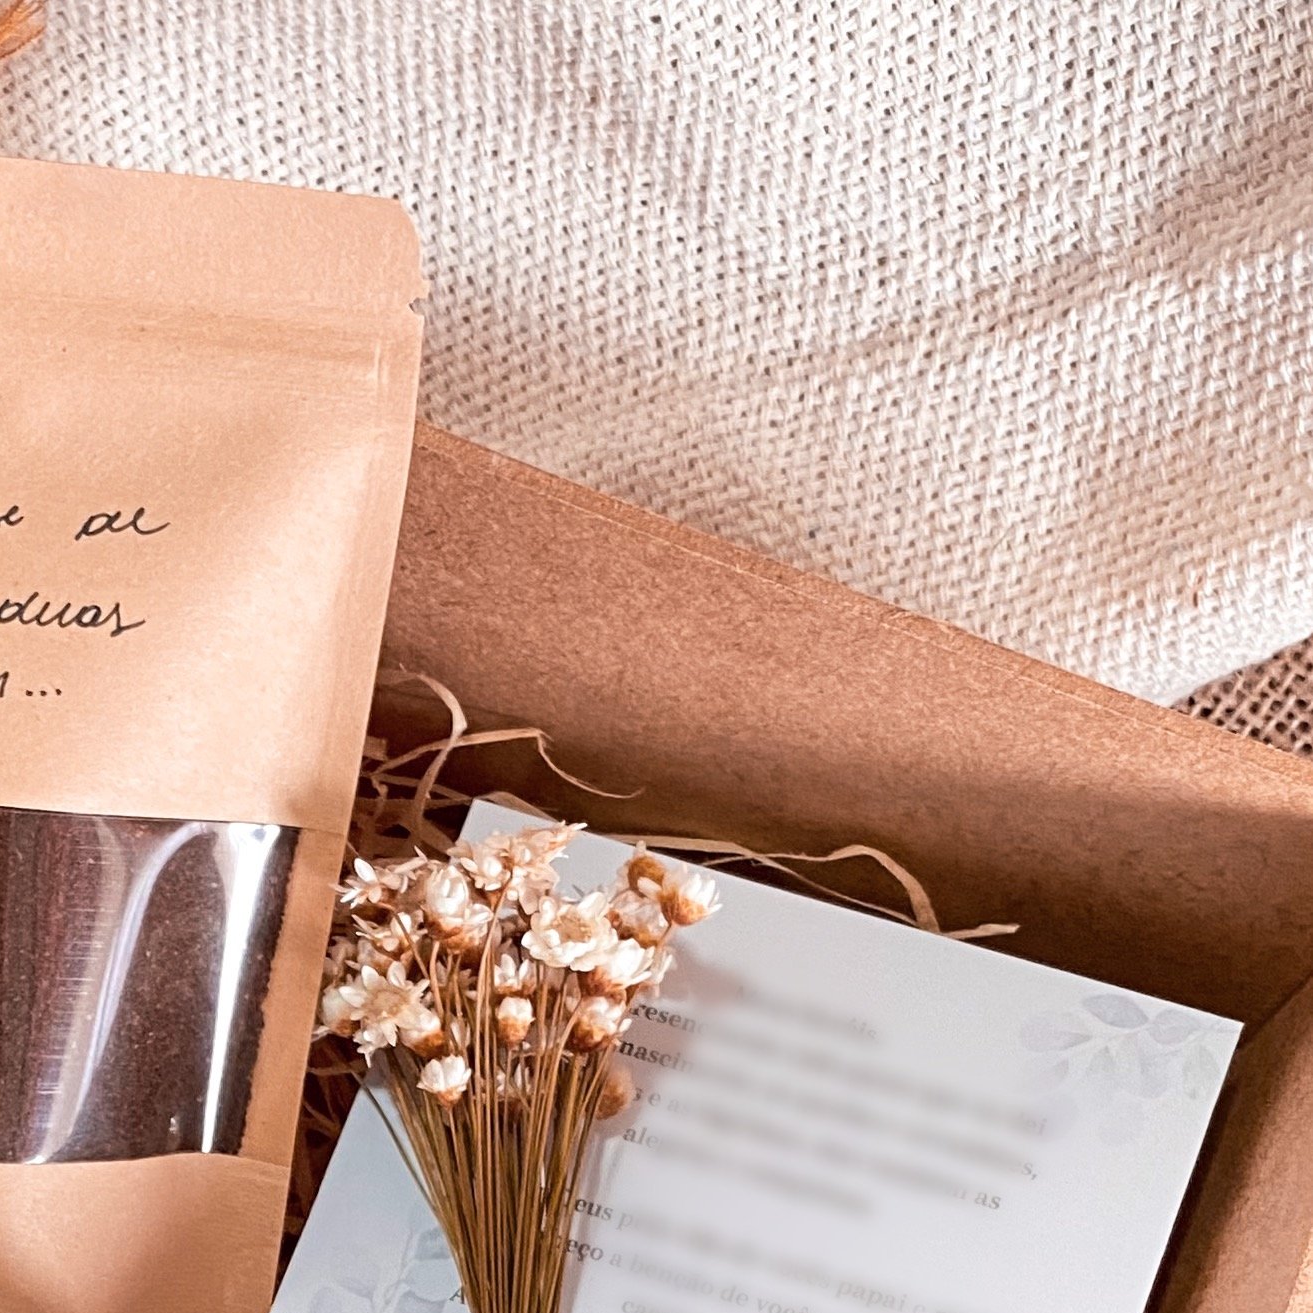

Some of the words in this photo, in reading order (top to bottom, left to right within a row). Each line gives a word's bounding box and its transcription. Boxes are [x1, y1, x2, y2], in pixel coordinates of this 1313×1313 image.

[74, 506, 171, 542] de
[973, 1190, 1003, 1211] as
[718, 1283, 750, 1308] de
[834, 1278, 909, 1313] papai
